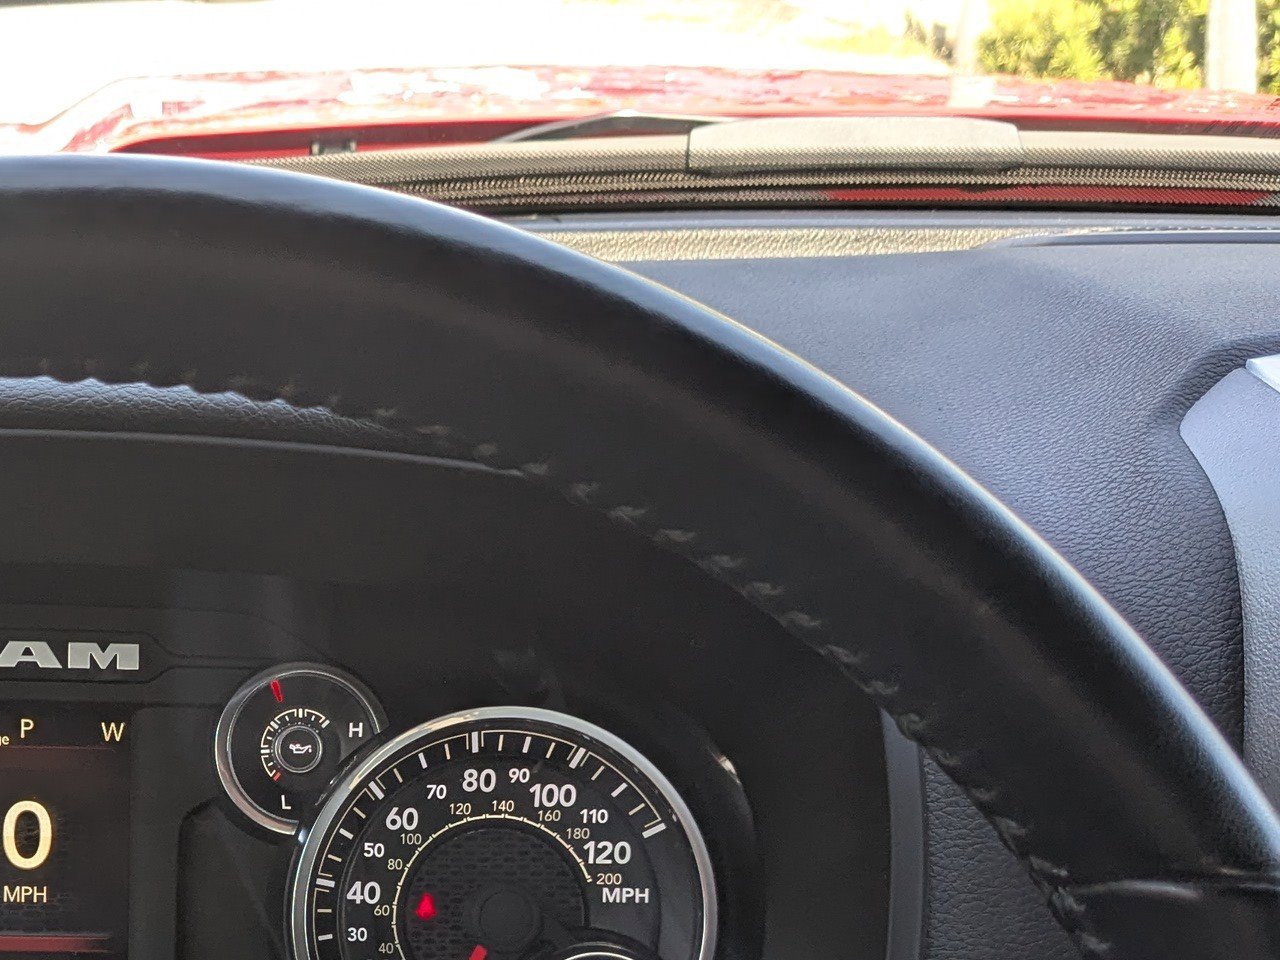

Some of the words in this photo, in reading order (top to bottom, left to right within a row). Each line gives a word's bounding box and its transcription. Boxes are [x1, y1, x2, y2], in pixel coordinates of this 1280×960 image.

[20, 719, 34, 738] P
[101, 722, 125, 741] W
[348, 722, 364, 738] H
[462, 769, 497, 793] 80
[508, 768, 530, 783] 90
[426, 784, 447, 800] 70
[529, 783, 577, 808] 100
[281, 794, 292, 810] L
[449, 803, 472, 815] 120
[492, 800, 515, 812] 140
[385, 807, 419, 831] 60
[537, 810, 561, 822] 160
[580, 808, 609, 824] 110
[2, 800, 53, 869] 0
[400, 833, 422, 845] 100
[566, 827, 590, 840] 180
[363, 842, 385, 858] 50
[583, 840, 632, 865] 120
[387, 858, 403, 870] 80
[596, 873, 622, 886] 200
[3, 886, 48, 902] MPH
[346, 881, 381, 905] 40
[602, 887, 649, 904] MPH
[373, 905, 390, 917] 60
[347, 927, 368, 942] 30
[378, 942, 394, 954] 40
